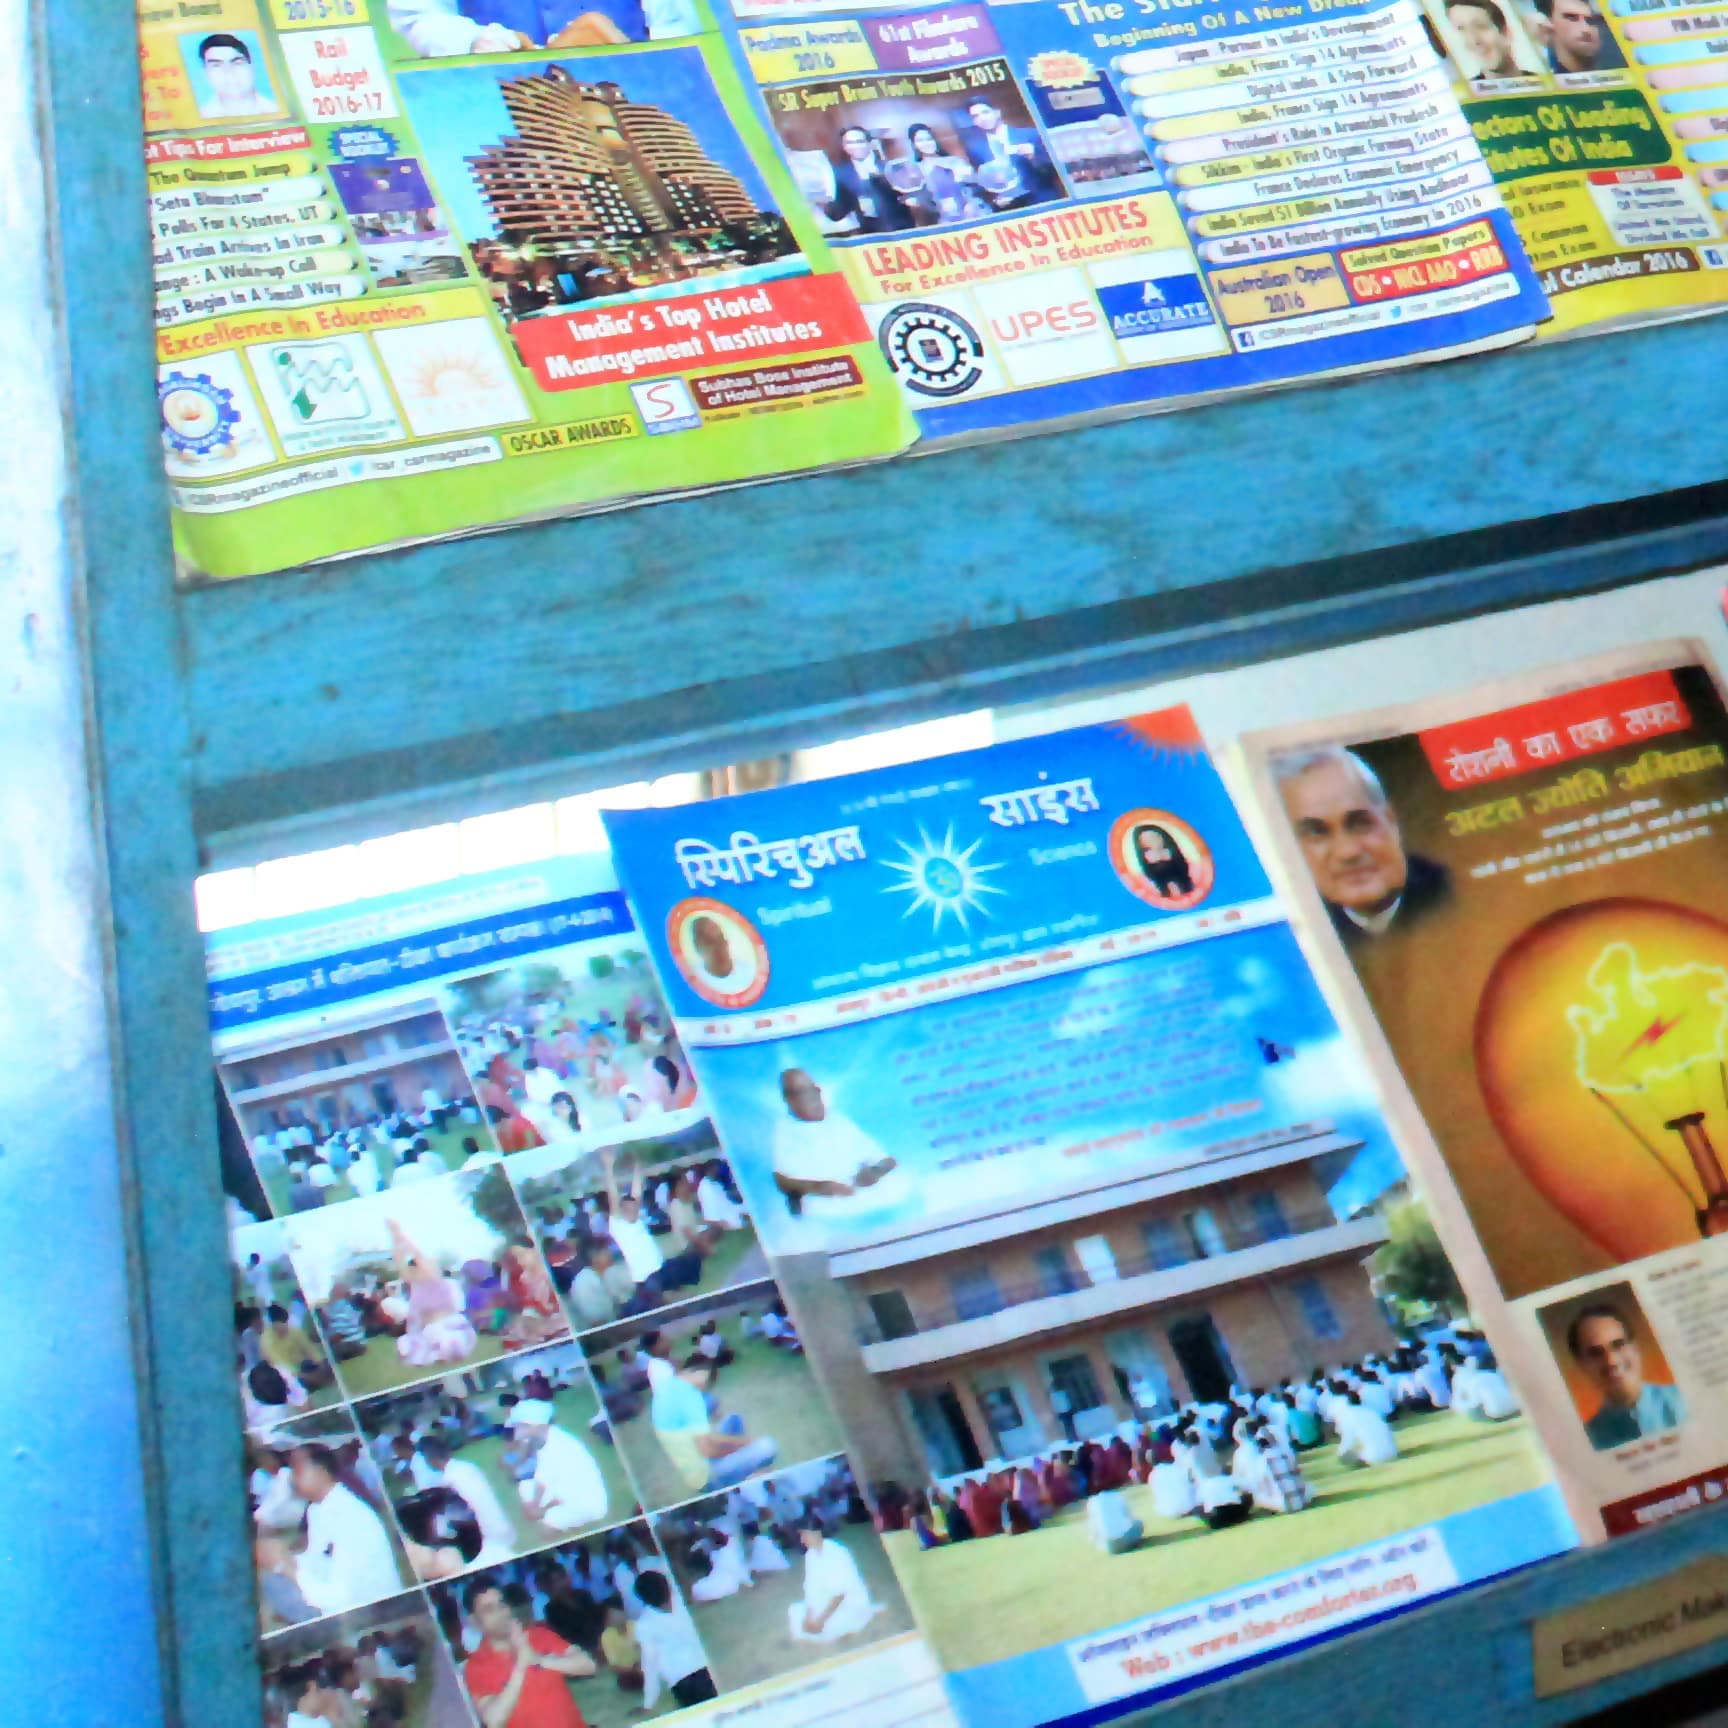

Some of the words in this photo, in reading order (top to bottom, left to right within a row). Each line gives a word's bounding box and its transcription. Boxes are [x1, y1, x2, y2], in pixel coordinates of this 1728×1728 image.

[1057, 0, 1126, 27] The
[1092, 20, 1198, 50] Beginning
[1201, 13, 1227, 30] Of
[1234, 9, 1252, 26] A
[1256, 4, 1304, 22] New
[966, 67, 1006, 91] 2015
[862, 232, 990, 278] LEADING
[992, 199, 1149, 253] INSTITUTES
[1643, 248, 1690, 272] 2016
[880, 278, 913, 295] For
[919, 257, 1027, 290] Excellence
[1030, 252, 1051, 268] In
[1056, 233, 1154, 261] Education
[567, 308, 656, 342] India's
[657, 302, 704, 330] Top
[703, 289, 774, 322] Hotel
[991, 299, 1098, 344] UPES
[1112, 301, 1210, 332] ACCURATE
[1263, 291, 1306, 315] 2016
[158, 321, 285, 356] Excellence
[318, 302, 427, 331] Education
[544, 336, 705, 380] Management
[710, 318, 823, 354] Institutes
[509, 429, 562, 454] OSCAR
[566, 417, 633, 443] AWARDS
[674, 826, 867, 891] स्पिरिचुअल
[980, 771, 1101, 829] साइंस
